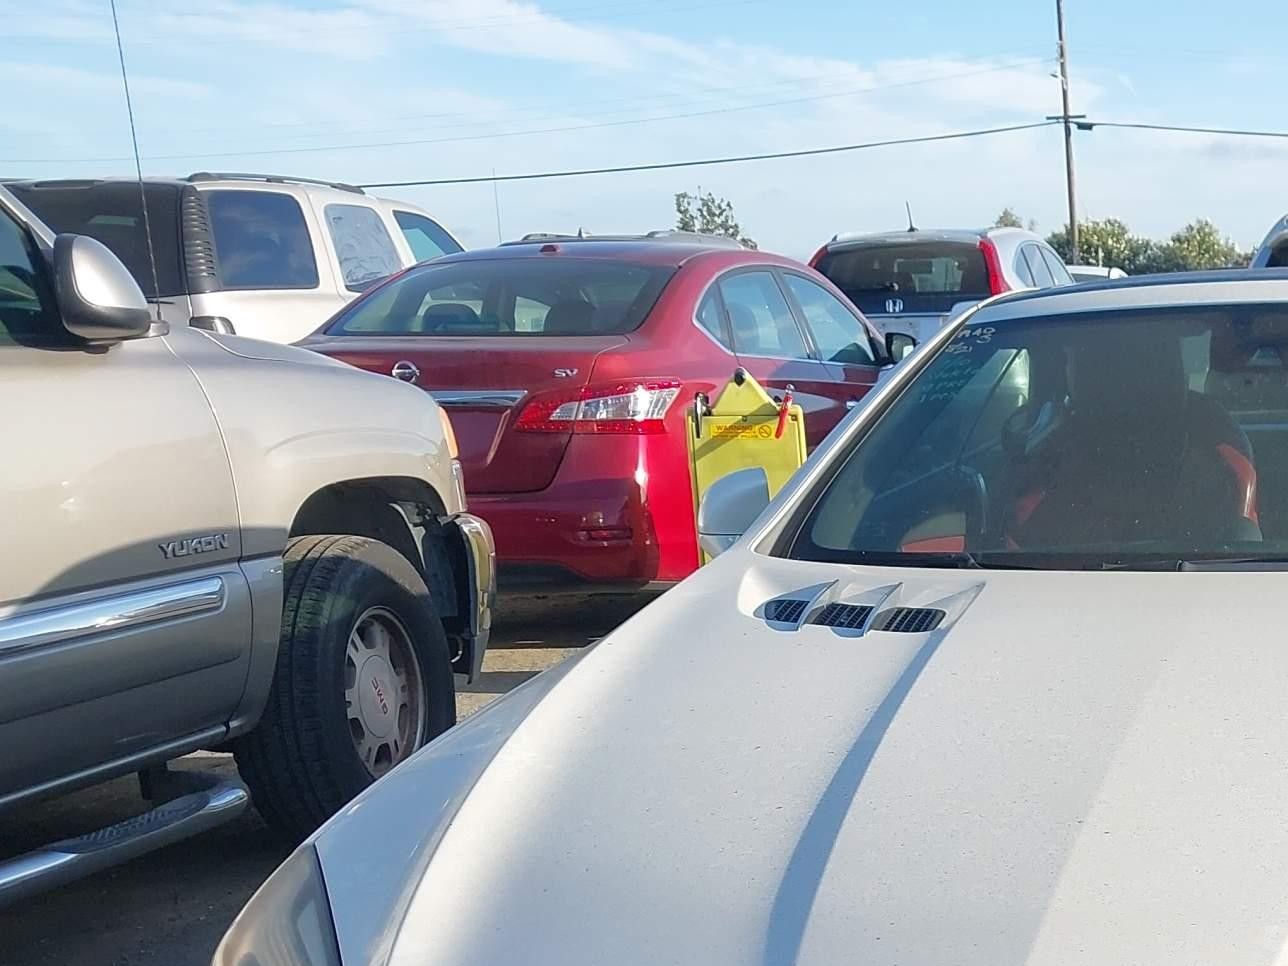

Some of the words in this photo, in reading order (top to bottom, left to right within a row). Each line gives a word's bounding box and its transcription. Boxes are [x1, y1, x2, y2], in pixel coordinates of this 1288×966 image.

[554, 368, 579, 378] SV
[158, 533, 229, 559] YUKON
[371, 676, 389, 715] GMC
